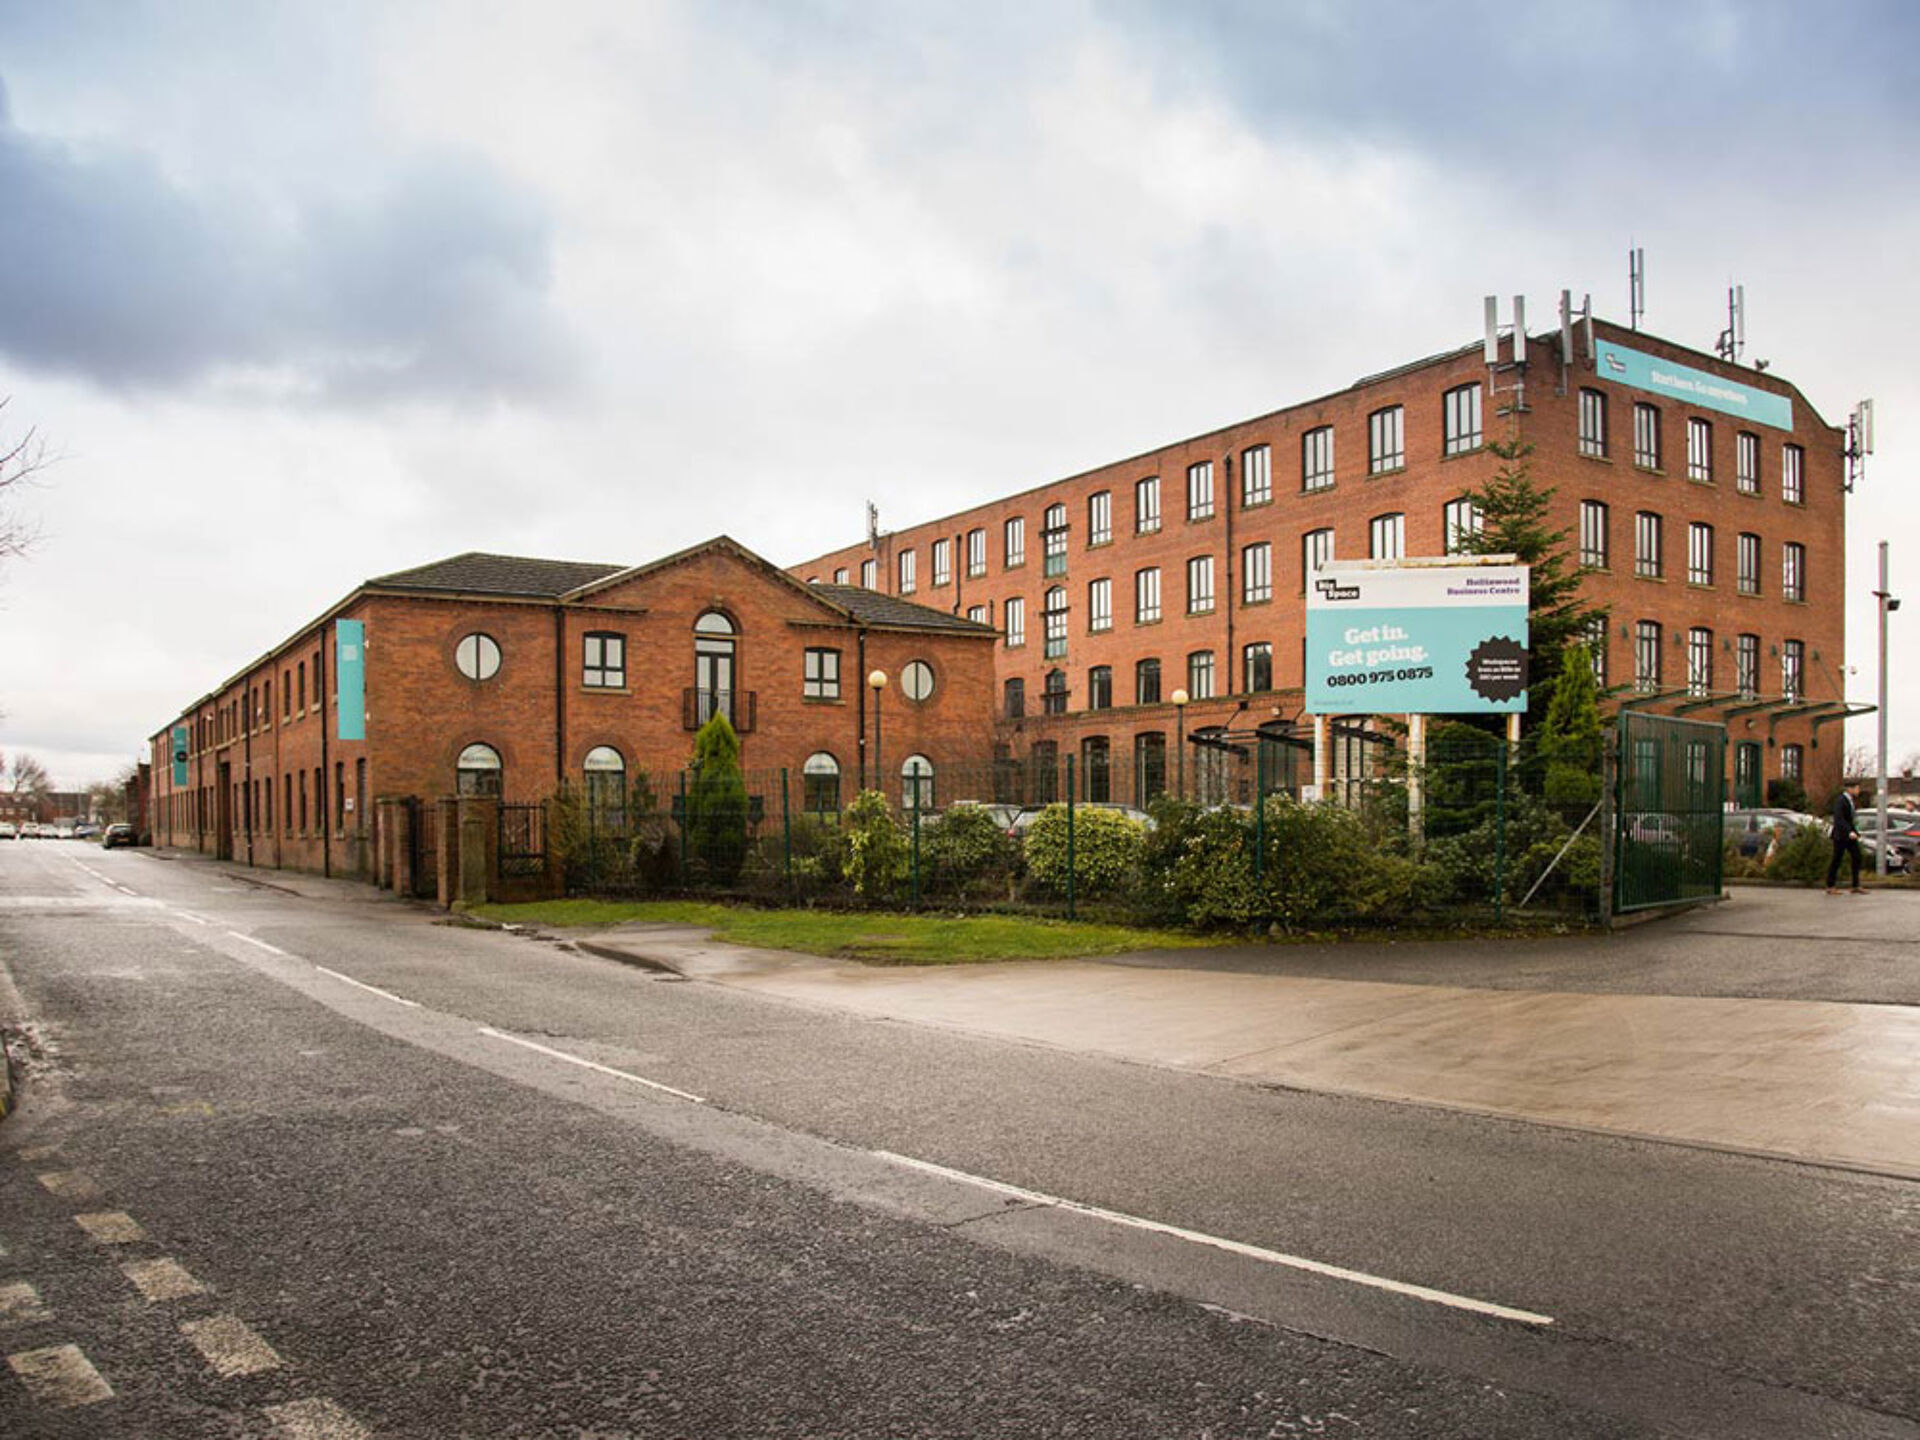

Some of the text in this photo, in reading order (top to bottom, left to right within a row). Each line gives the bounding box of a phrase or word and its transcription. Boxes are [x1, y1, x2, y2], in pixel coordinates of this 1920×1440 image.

[1447, 586, 1520, 596] Business Centre
[1344, 624, 1409, 645] Get in.
[1328, 645, 1429, 667] Get going.
[1327, 666, 1433, 688] 0800 975 0875
